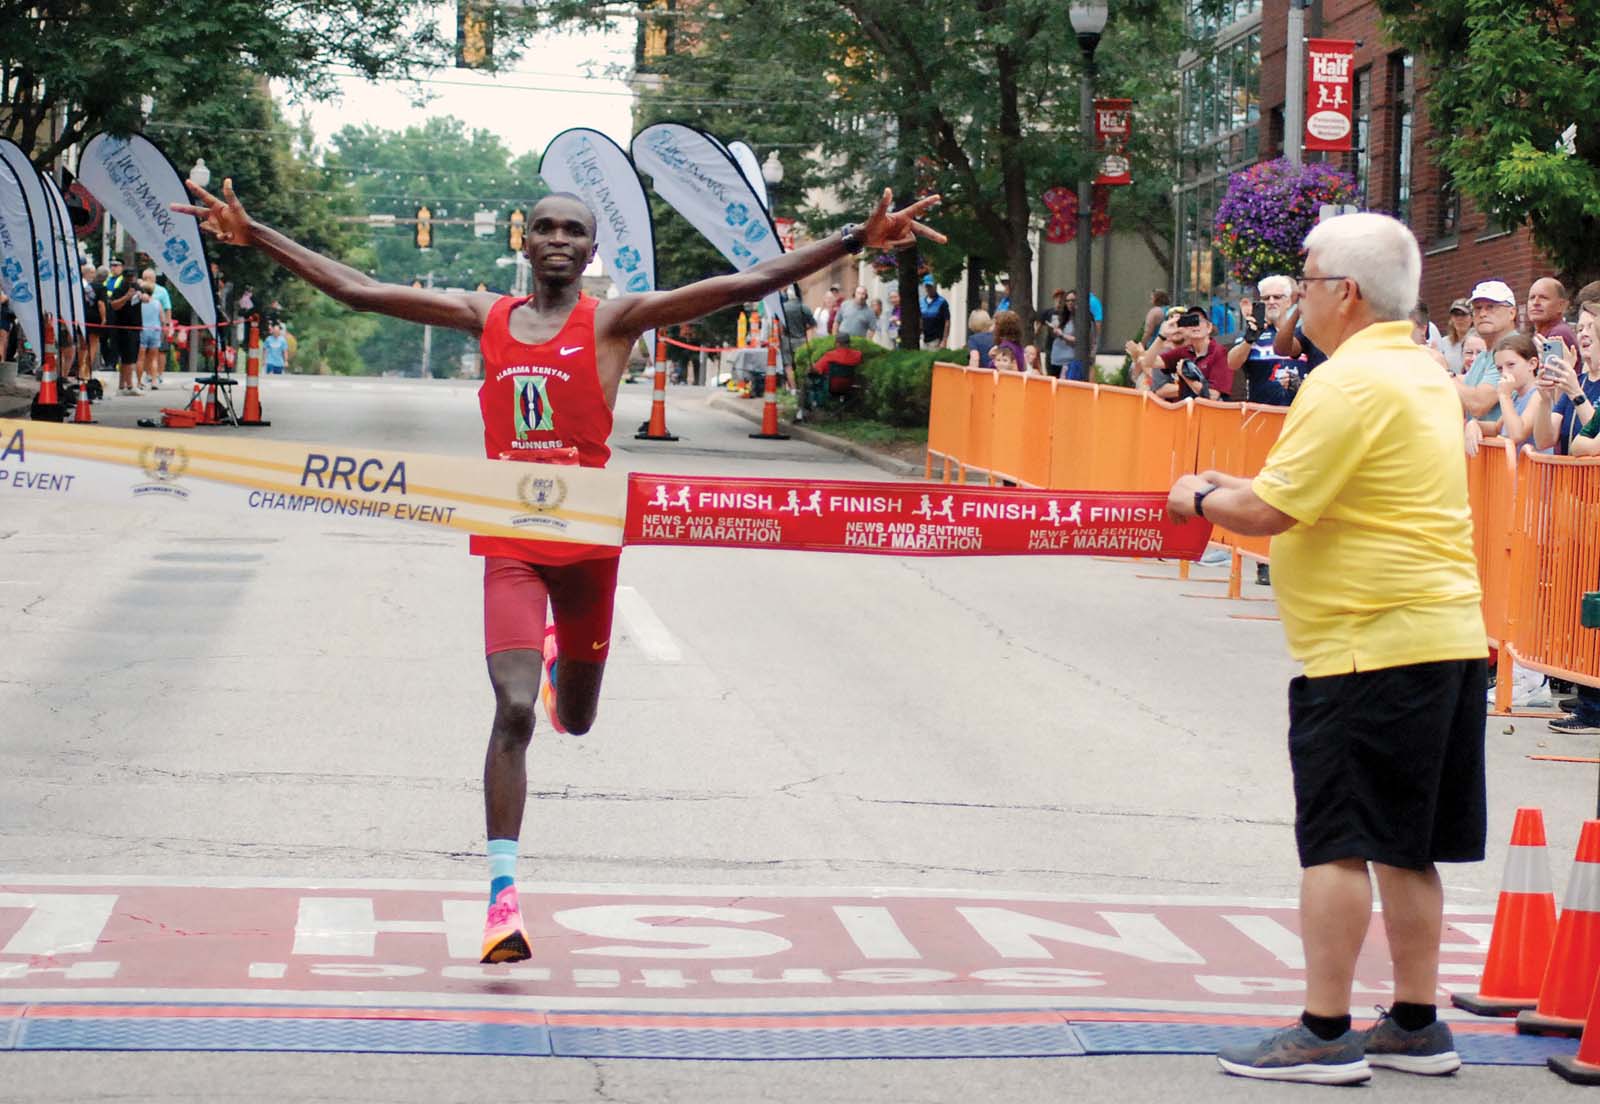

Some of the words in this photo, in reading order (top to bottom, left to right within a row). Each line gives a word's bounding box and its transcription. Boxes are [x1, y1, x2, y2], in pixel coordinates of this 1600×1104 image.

[1313, 57, 1349, 75] Half
[111, 146, 175, 234] HIGHMARK
[495, 366, 530, 382] ALABAMA
[532, 366, 570, 382] KENYAN
[0, 428, 25, 462] A
[511, 440, 563, 449] RUNNERS
[12, 471, 75, 492] EVENT
[300, 453, 408, 495] RRCA
[248, 491, 391, 517] CHAMPIONSHIP
[394, 503, 457, 523] EVENT
[698, 492, 773, 511] FINISH
[830, 496, 902, 514] FINISH
[962, 502, 1036, 520] FINISH
[1090, 507, 1163, 523] FINISH
[643, 514, 681, 526] NEWS
[686, 516, 713, 527] AND
[718, 517, 781, 529] SENTINEL
[846, 522, 884, 533] NEWS
[888, 523, 915, 534] AND
[919, 524, 982, 537] SENTINEL
[642, 524, 685, 539] HALF
[689, 525, 781, 543] MARATHON
[844, 532, 887, 548] HALF
[890, 533, 982, 550] MARATHON
[1029, 528, 1067, 539] NEWS
[1071, 528, 1098, 537] AND
[1102, 528, 1163, 539] SENTINEL
[1028, 536, 1070, 550] HALF
[1073, 535, 1163, 552] MARATHON
